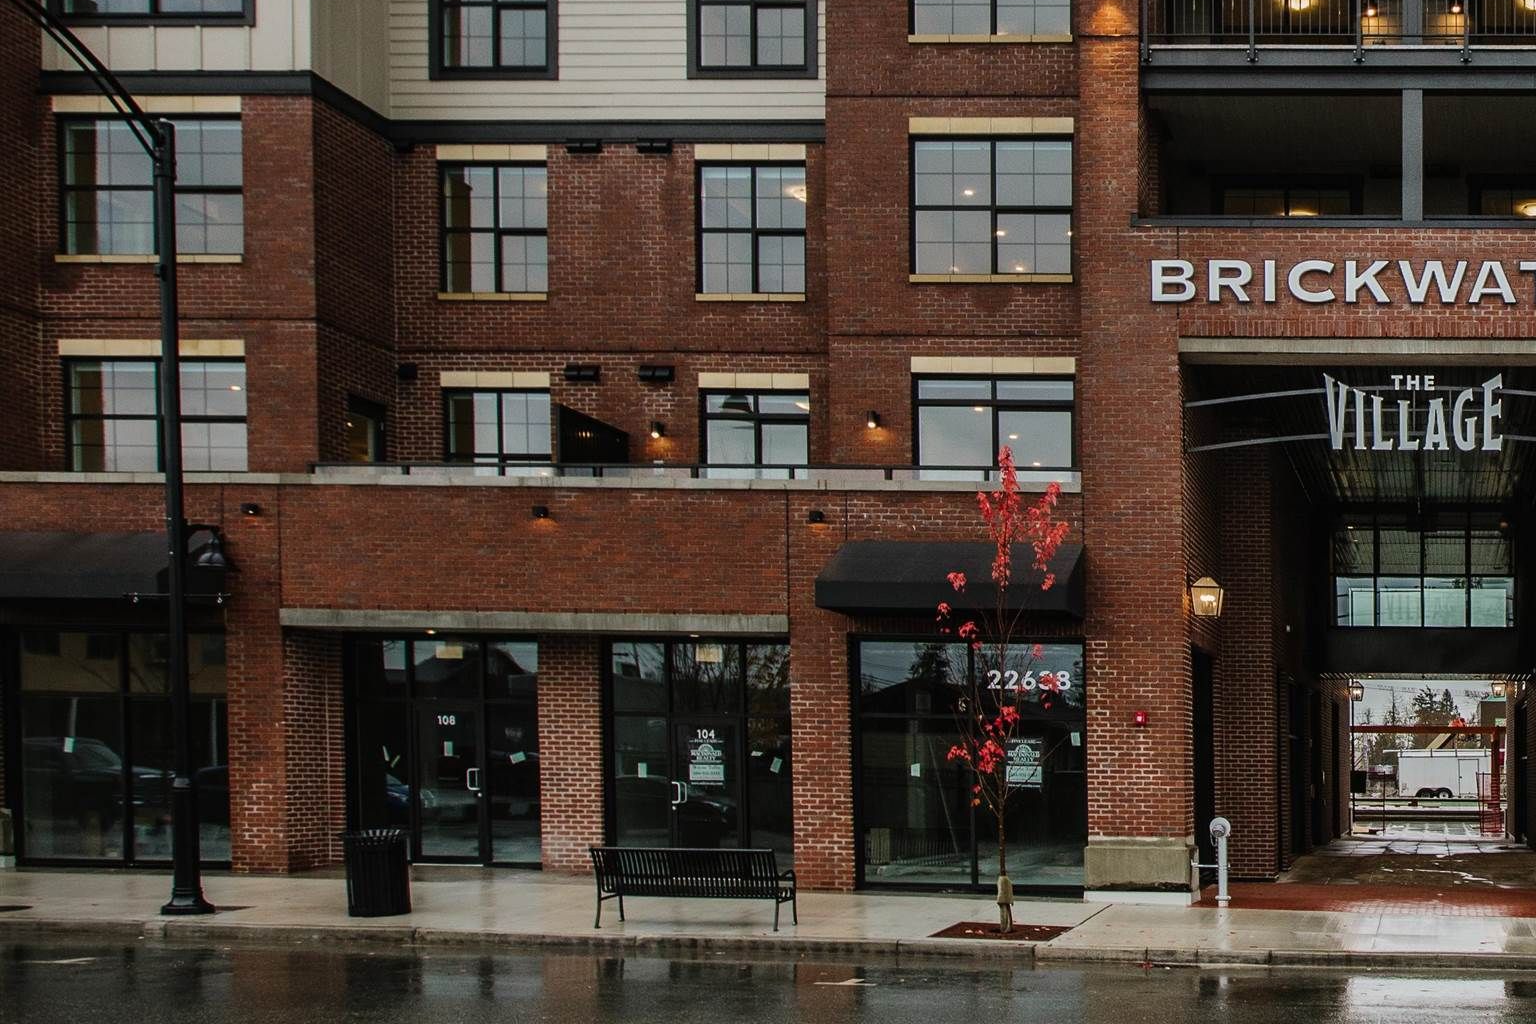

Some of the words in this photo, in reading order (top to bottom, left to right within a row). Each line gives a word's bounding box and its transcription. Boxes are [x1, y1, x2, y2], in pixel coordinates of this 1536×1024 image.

[1391, 374, 1436, 392] THE
[1322, 372, 1504, 452] VILLAGE
[437, 715, 456, 726] 108
[697, 729, 715, 739] 104
